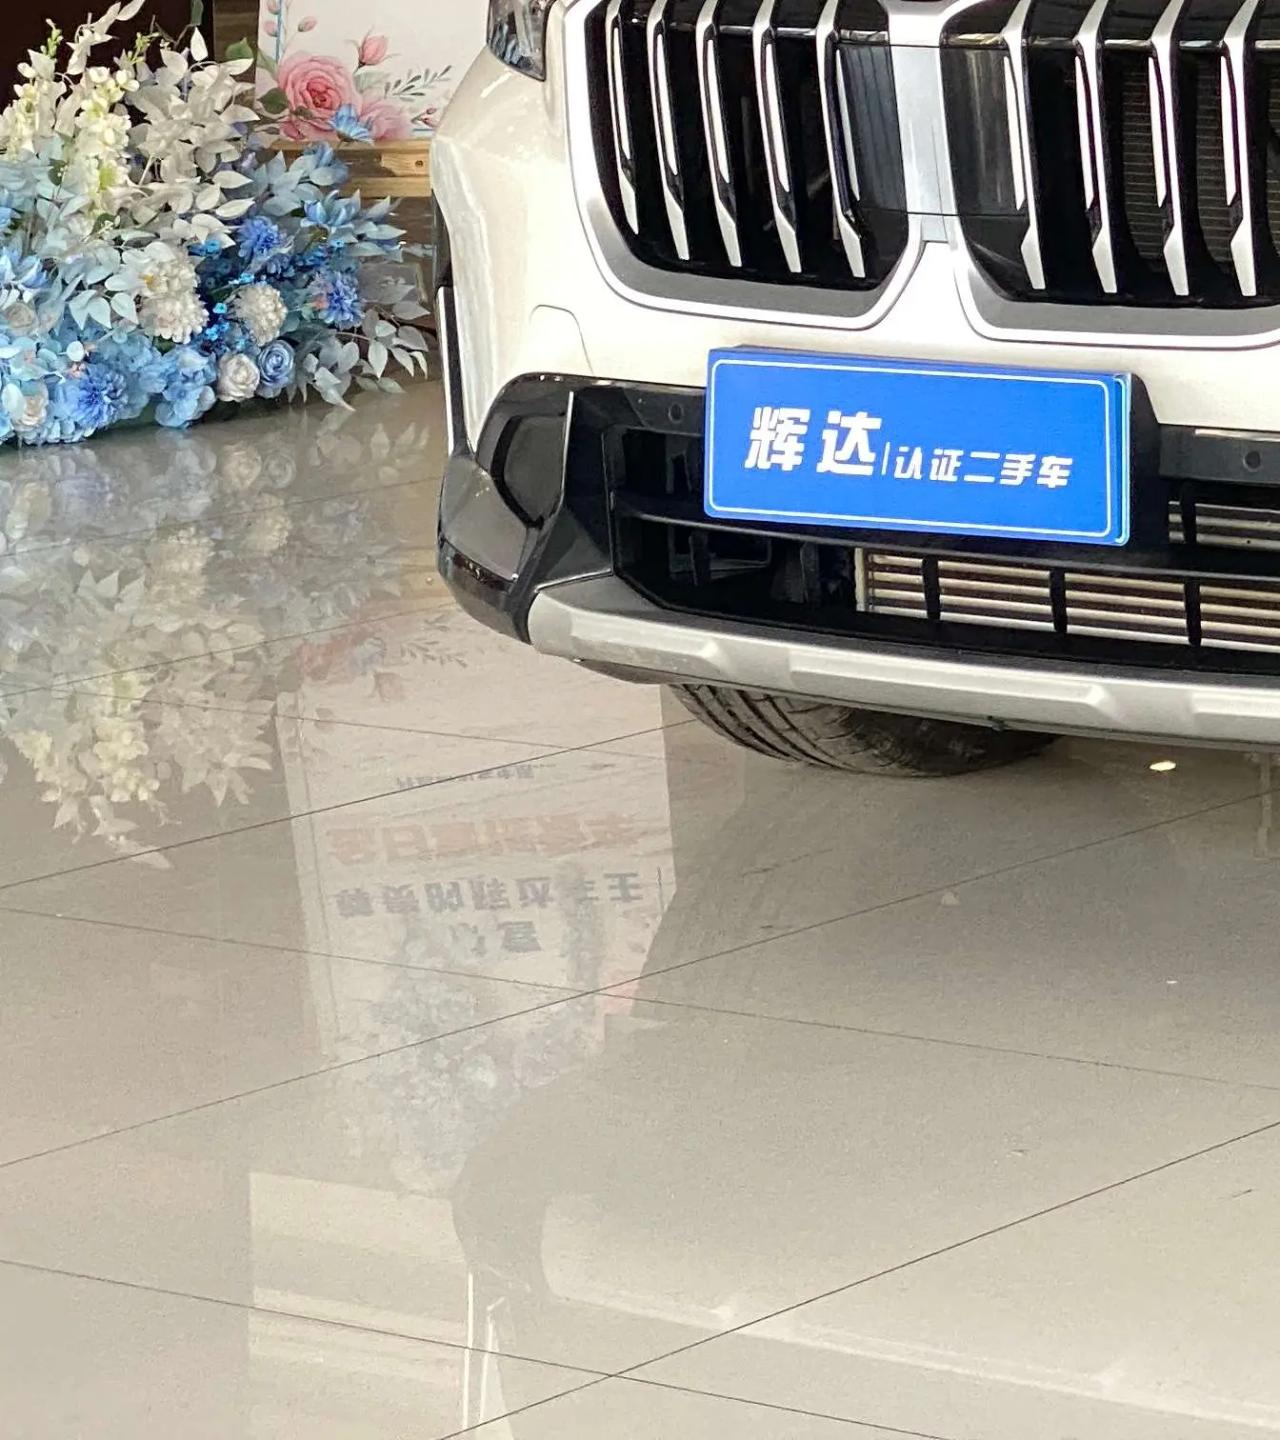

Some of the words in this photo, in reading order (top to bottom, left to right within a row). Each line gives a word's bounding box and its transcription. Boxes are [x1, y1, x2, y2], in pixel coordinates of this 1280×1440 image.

[744, 406, 882, 476] 辉达
[893, 445, 1074, 488] 认证二手车
